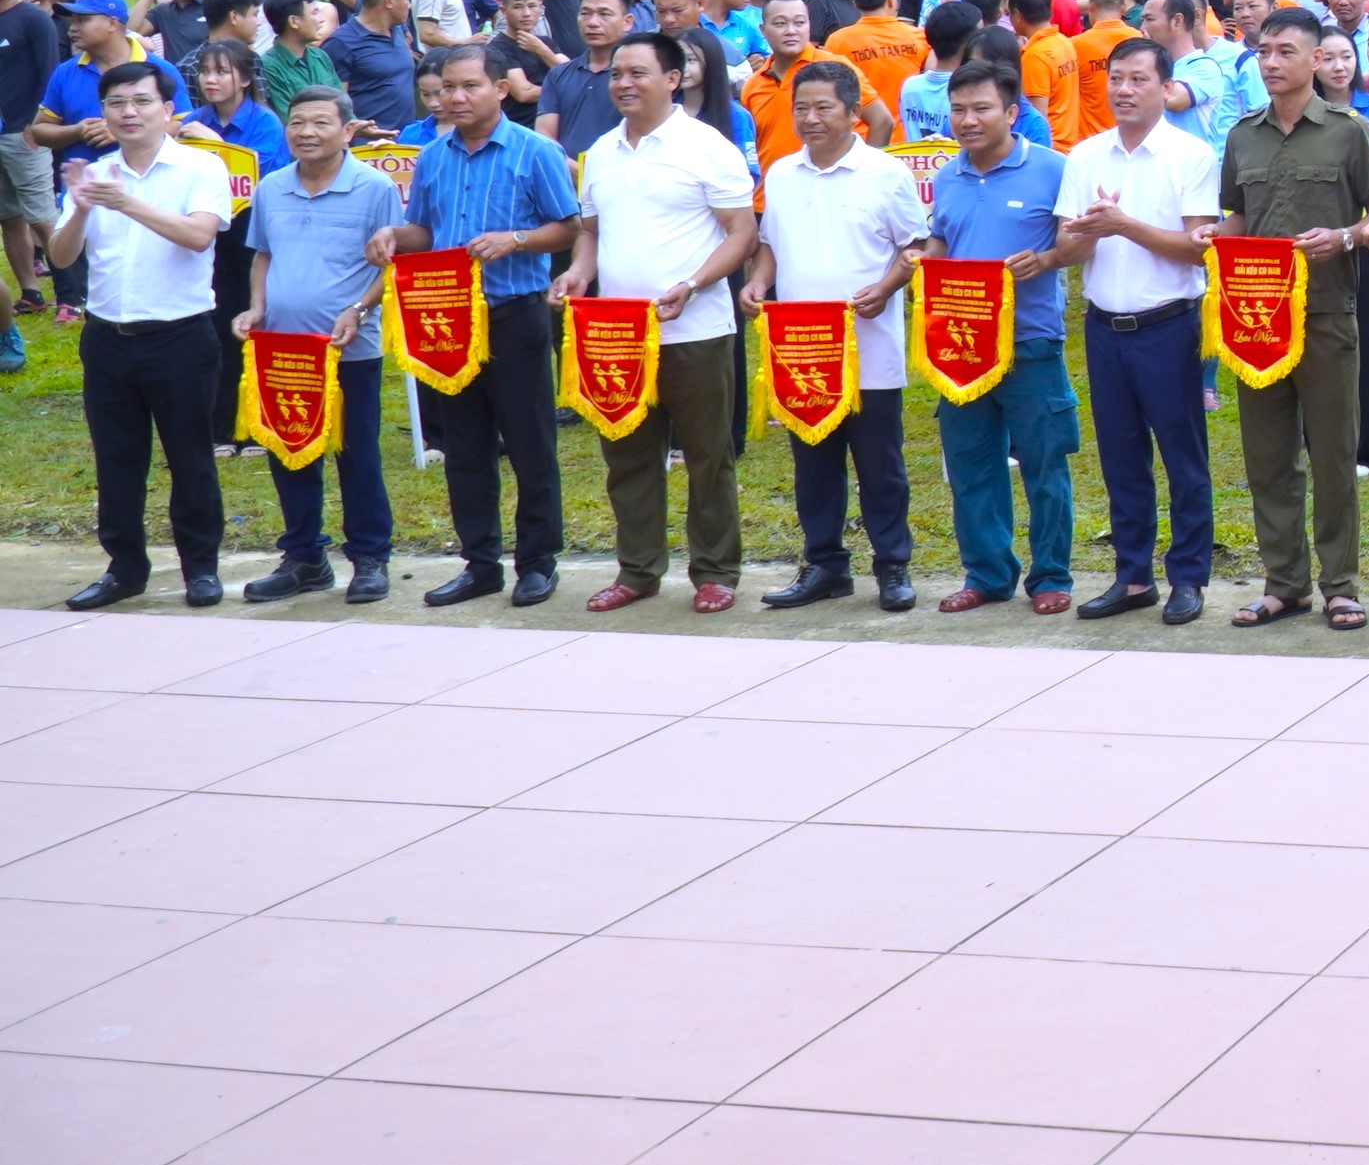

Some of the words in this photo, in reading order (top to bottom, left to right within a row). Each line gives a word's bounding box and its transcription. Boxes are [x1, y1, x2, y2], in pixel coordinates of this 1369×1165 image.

[851, 45, 878, 62] THÔN
[1088, 55, 1108, 72] THÔ
[360, 153, 418, 172] ÔN
